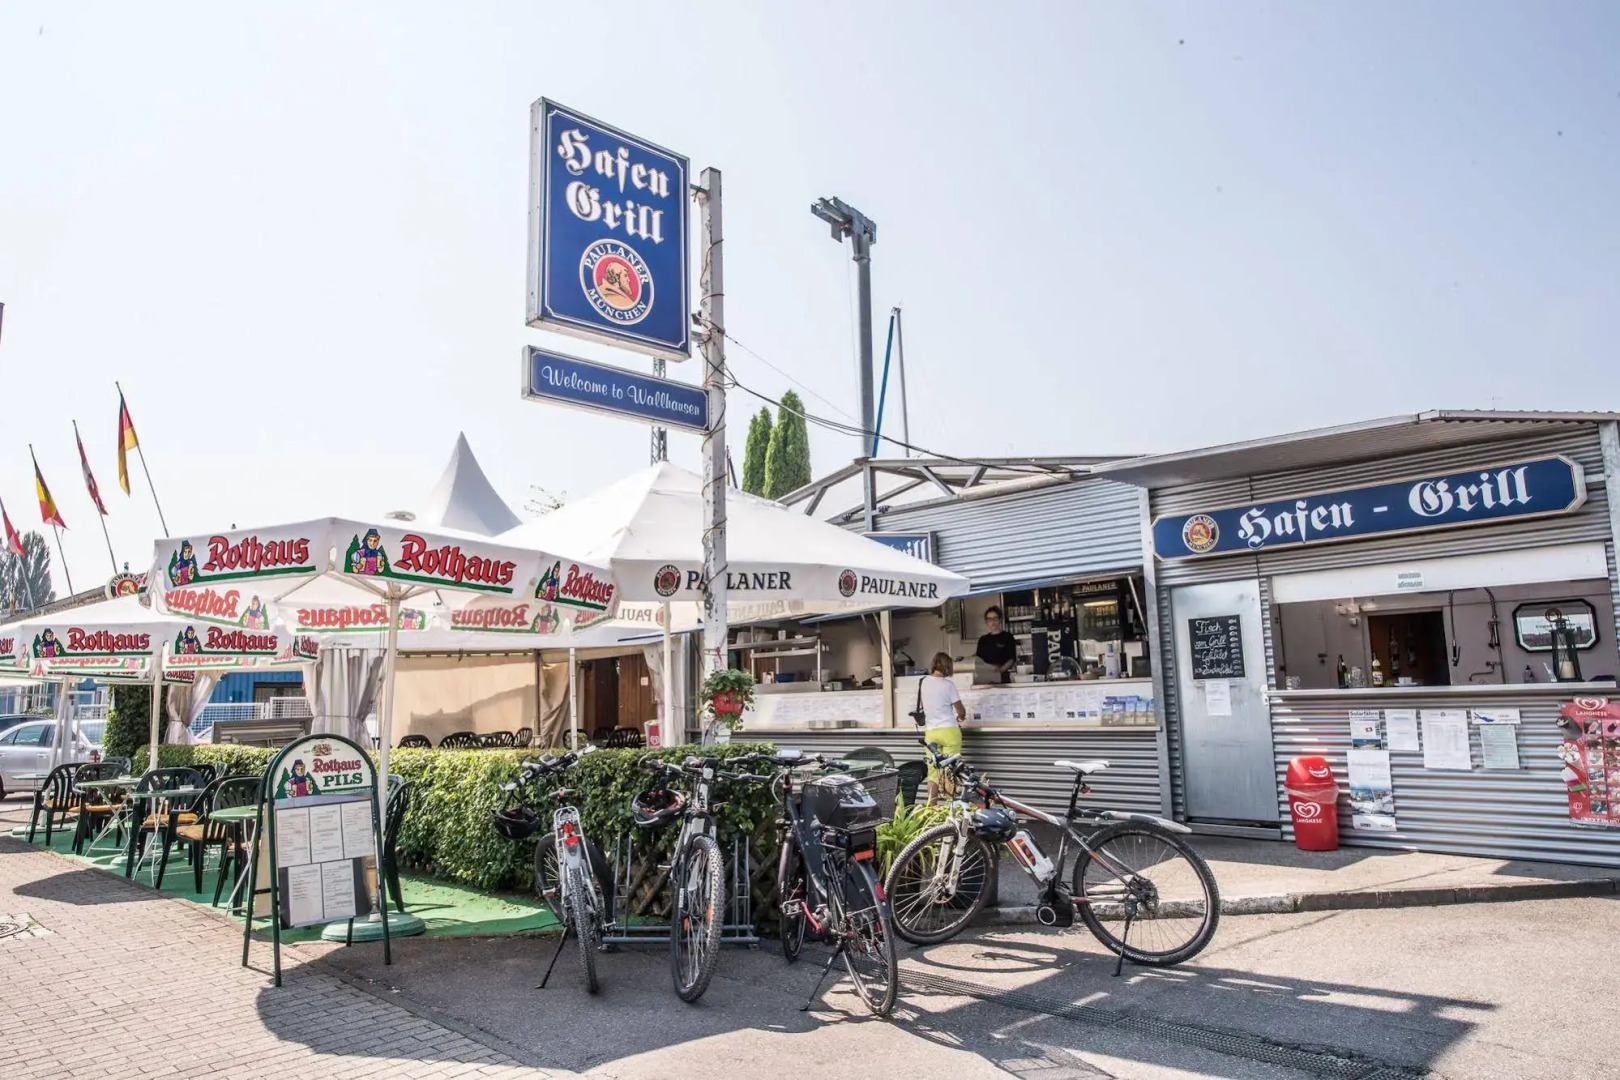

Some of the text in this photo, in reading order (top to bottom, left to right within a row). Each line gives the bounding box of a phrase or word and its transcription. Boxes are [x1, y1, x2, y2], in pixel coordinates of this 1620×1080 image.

[557, 127, 671, 200] Hafen
[565, 180, 665, 245] Grill
[584, 242, 649, 285] PAULANER
[587, 286, 649, 321] MÜNCHEN
[541, 365, 701, 417] Welcome to Wallhausen
[1237, 499, 1355, 549] Hafen
[1408, 466, 1533, 517] Grill
[202, 535, 311, 573] Rothaus
[394, 533, 517, 586] Rothaus
[560, 563, 615, 605] Rothaus
[685, 570, 792, 590] PALANER
[860, 575, 939, 599] PAULANER
[67, 627, 151, 653] Rothaus
[204, 626, 279, 652] Rothaus
[312, 757, 362, 774] Rothaus
[323, 772, 364, 788] PILS
